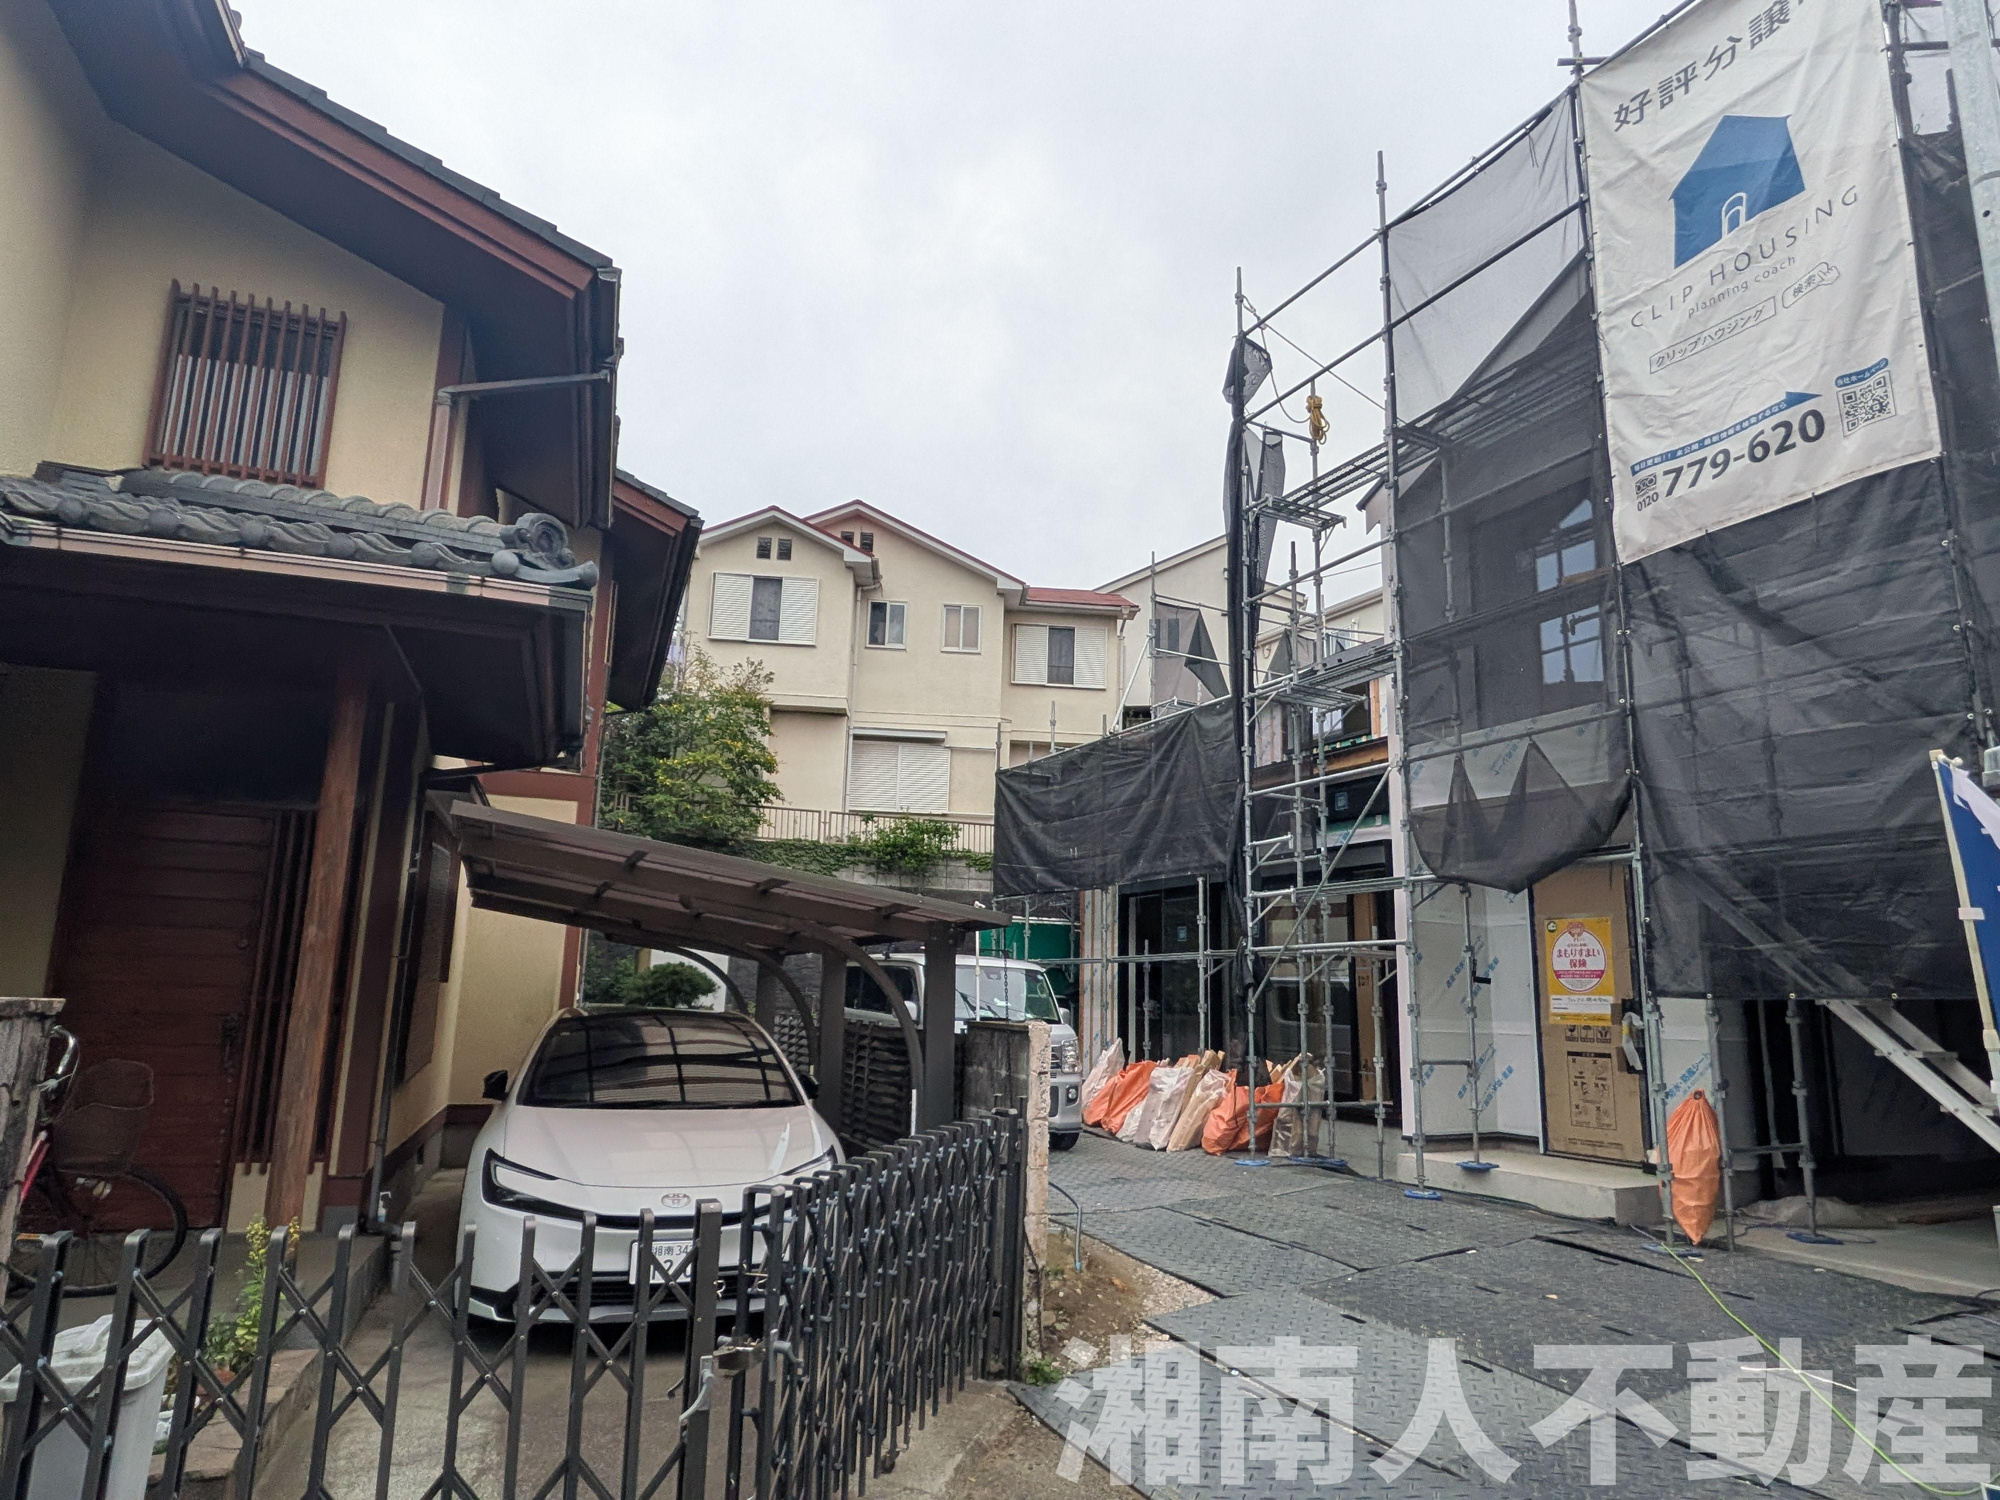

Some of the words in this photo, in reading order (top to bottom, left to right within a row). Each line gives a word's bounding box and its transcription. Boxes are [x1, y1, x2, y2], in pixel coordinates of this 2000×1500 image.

[1613, 0, 1805, 132] 好評分譲
[1630, 284, 1694, 328] CLIP
[1709, 184, 1859, 286] HOUSING
[1687, 280, 1750, 319] planning
[1753, 254, 1797, 283] coach
[1793, 274, 1816, 298] 検索
[1654, 306, 1766, 370] クリップハウジング
[1662, 408, 1826, 498] 779-620
[1637, 491, 1659, 511] 0120
[1556, 948, 1601, 958] まもりすまい
[1569, 959, 1588, 969] 保険
